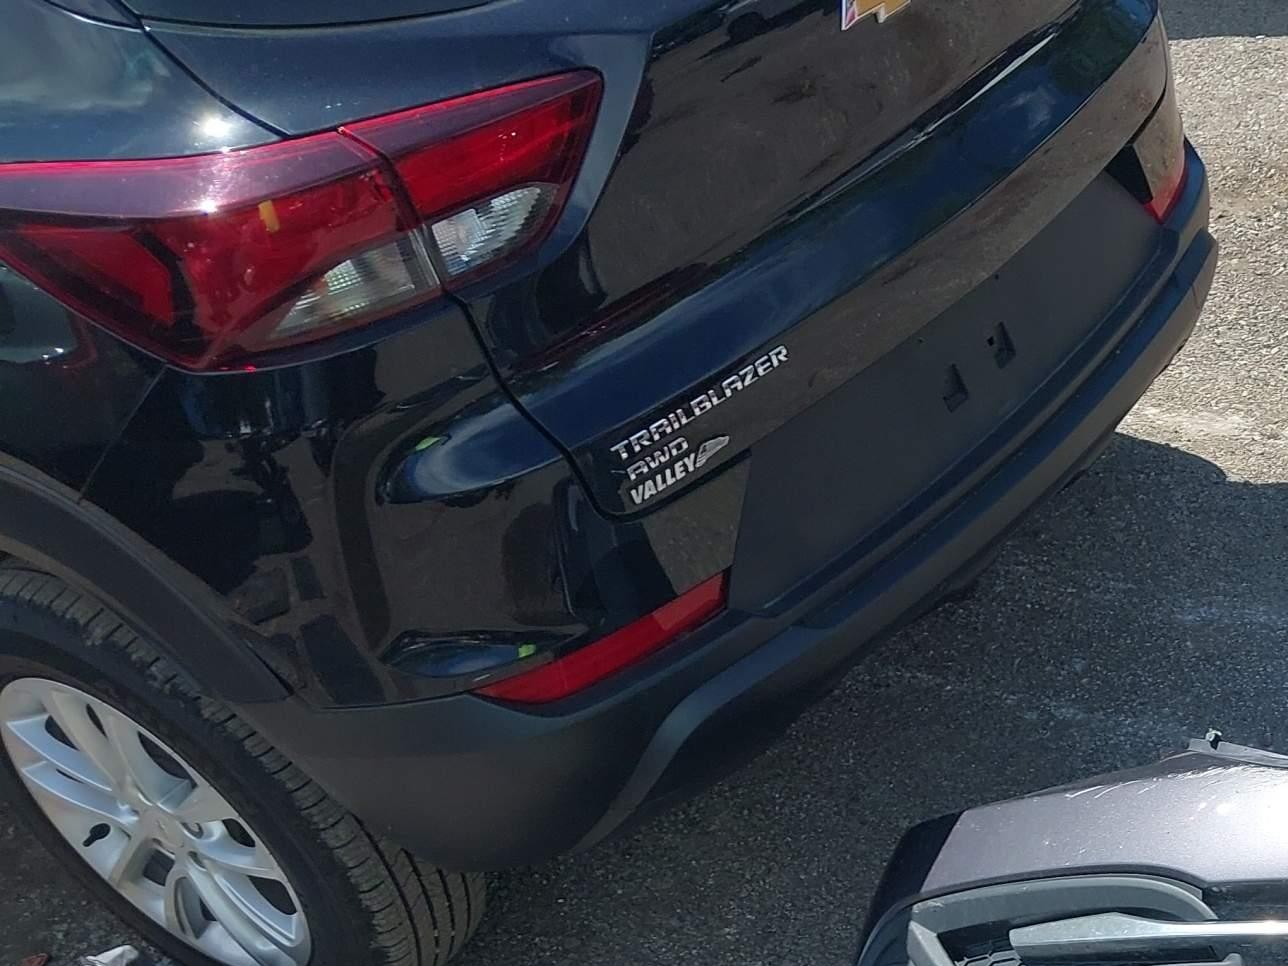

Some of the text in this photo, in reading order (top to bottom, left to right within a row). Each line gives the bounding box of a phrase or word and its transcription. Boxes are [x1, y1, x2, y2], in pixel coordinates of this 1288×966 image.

[610, 345, 790, 460] TRAILBLAZER
[626, 437, 689, 481] AWD
[630, 453, 696, 505] VALLEY
